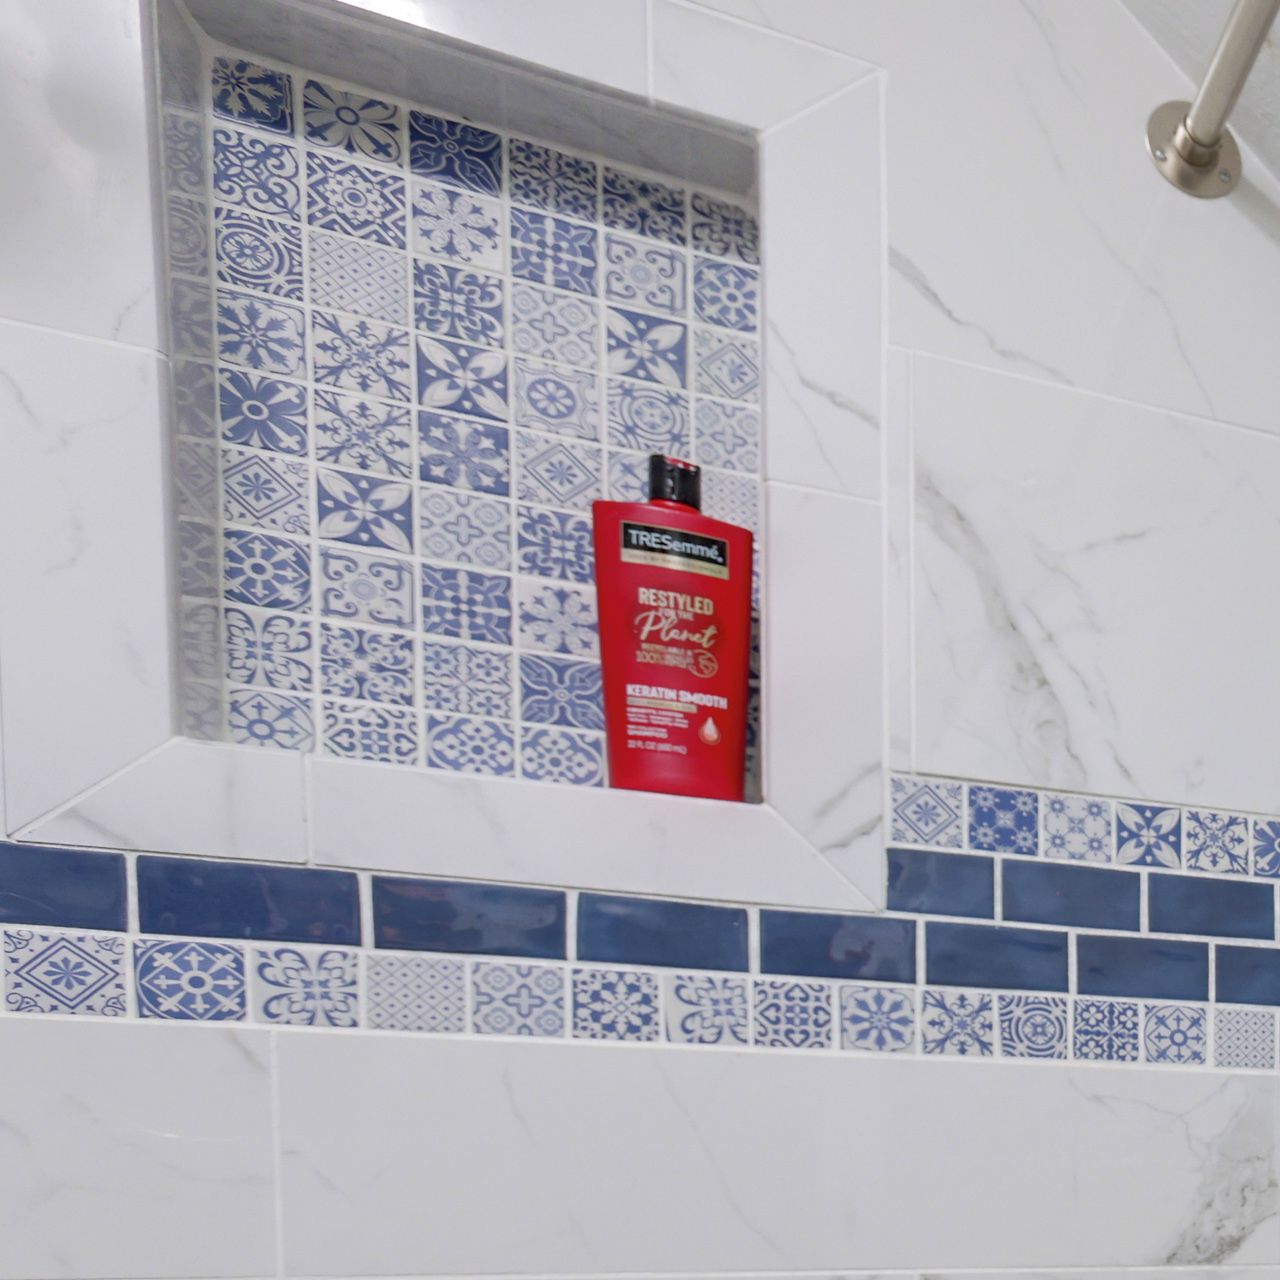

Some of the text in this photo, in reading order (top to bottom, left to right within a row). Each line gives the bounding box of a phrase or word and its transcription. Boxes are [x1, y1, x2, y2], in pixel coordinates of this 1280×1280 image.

[628, 529, 720, 559] TRESemmé
[638, 587, 715, 616] RESTYLED
[634, 610, 717, 648] Planet
[626, 683, 678, 701] KERATIN
[678, 689, 728, 710] SMOOTH
